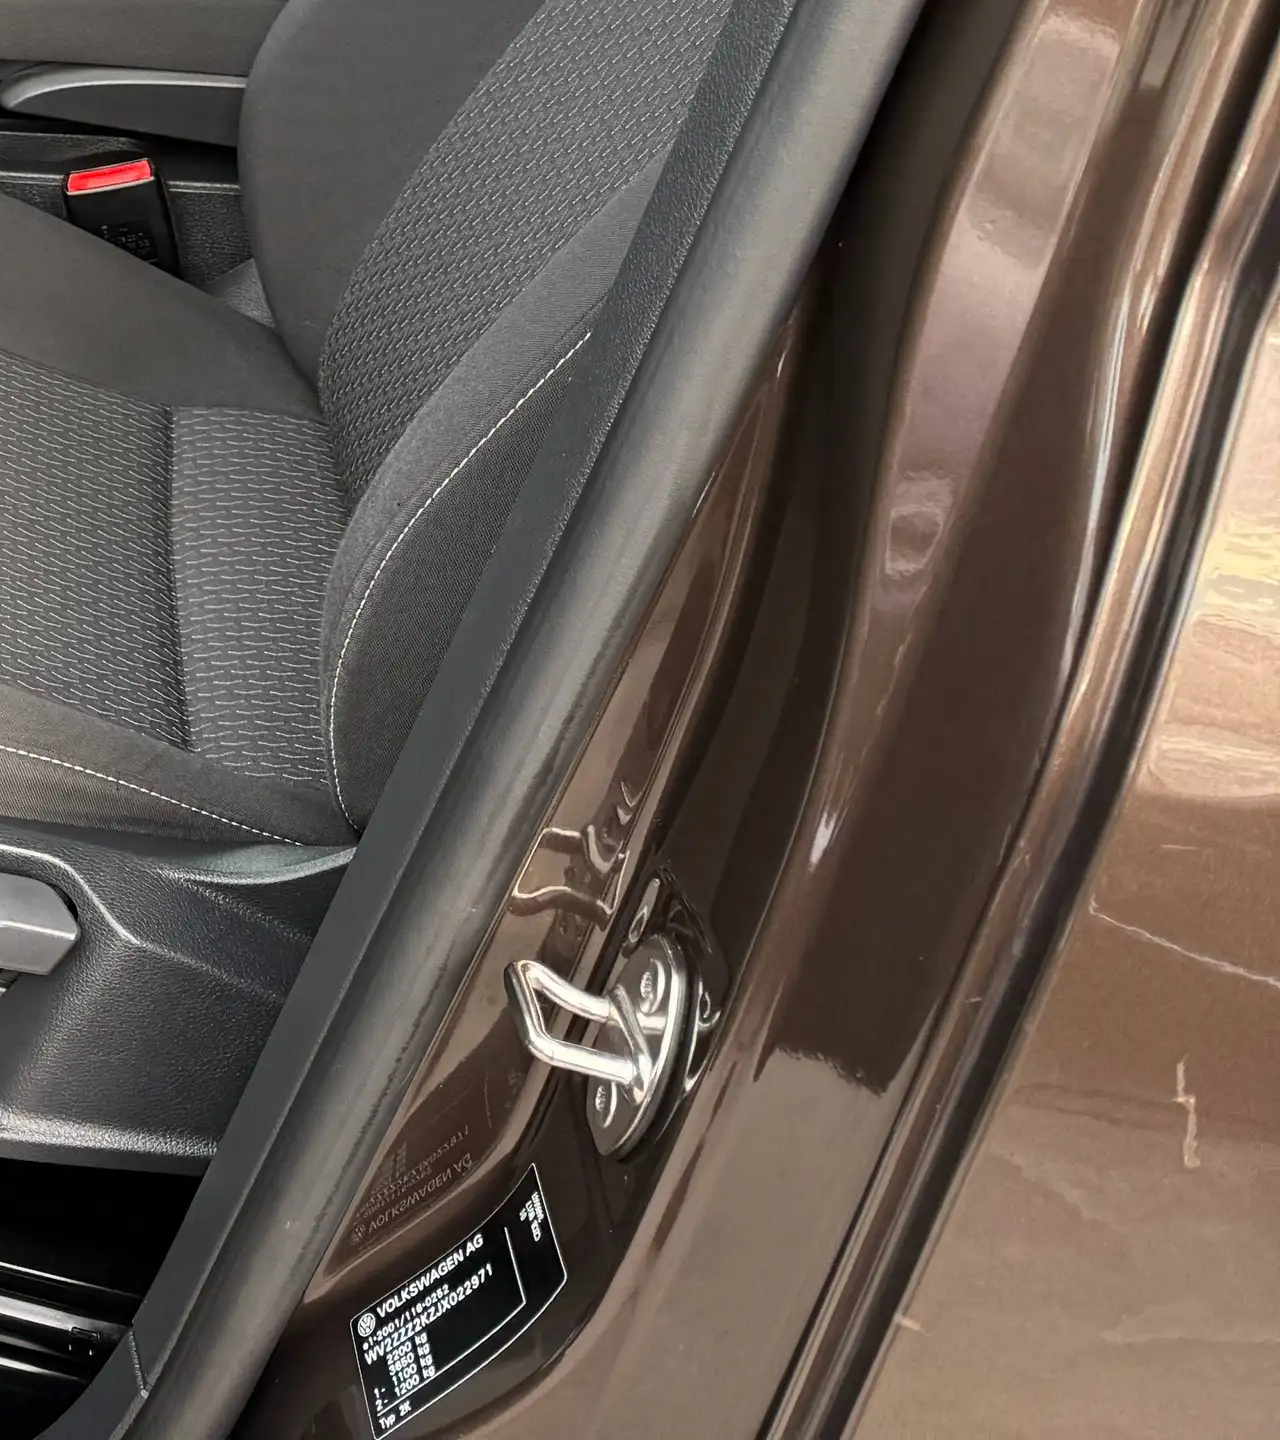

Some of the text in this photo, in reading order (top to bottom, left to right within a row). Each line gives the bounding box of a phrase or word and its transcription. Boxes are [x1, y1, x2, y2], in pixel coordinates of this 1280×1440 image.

[376, 1250, 464, 1317] VOLKSWAGEN
[465, 1233, 484, 1256] AG
[365, 1263, 493, 1365] WV2ZZZ2KZJX022971
[386, 1332, 428, 1365] 2200 kg
[417, 1343, 430, 1357] kg
[392, 1363, 417, 1386] 1100
[420, 1354, 433, 1367] kg
[394, 1374, 420, 1397] 1200
[422, 1365, 436, 1379] kg
[378, 1400, 412, 1429] Typ 2K
